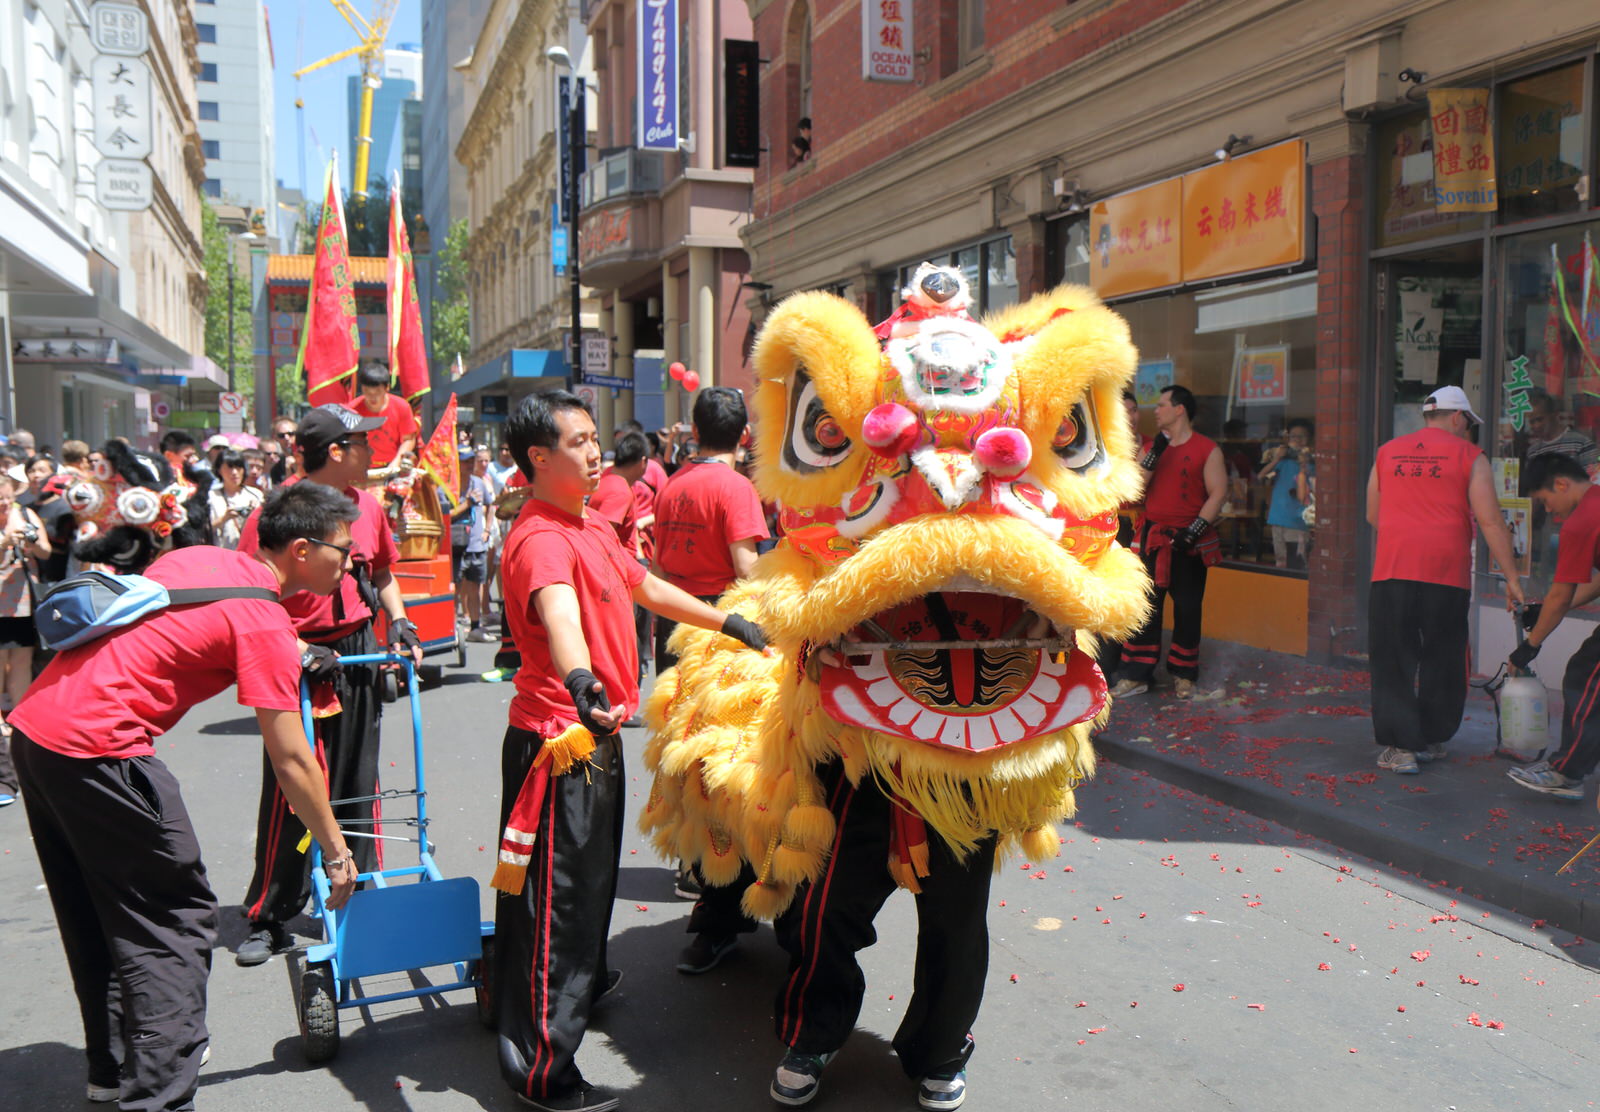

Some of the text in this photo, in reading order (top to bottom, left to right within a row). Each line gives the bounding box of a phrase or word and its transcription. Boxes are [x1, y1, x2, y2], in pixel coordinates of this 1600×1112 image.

[871, 51, 911, 65] OCEAN
[875, 63, 907, 76] GOLD
[106, 61, 140, 151] 大長今
[646, 122, 674, 142] Club
[109, 178, 140, 195] BBQ
[1434, 186, 1496, 206] Sovenir
[588, 341, 606, 349] ONE
[588, 352, 607, 360] WAY
[1503, 355, 1533, 433] 王子
